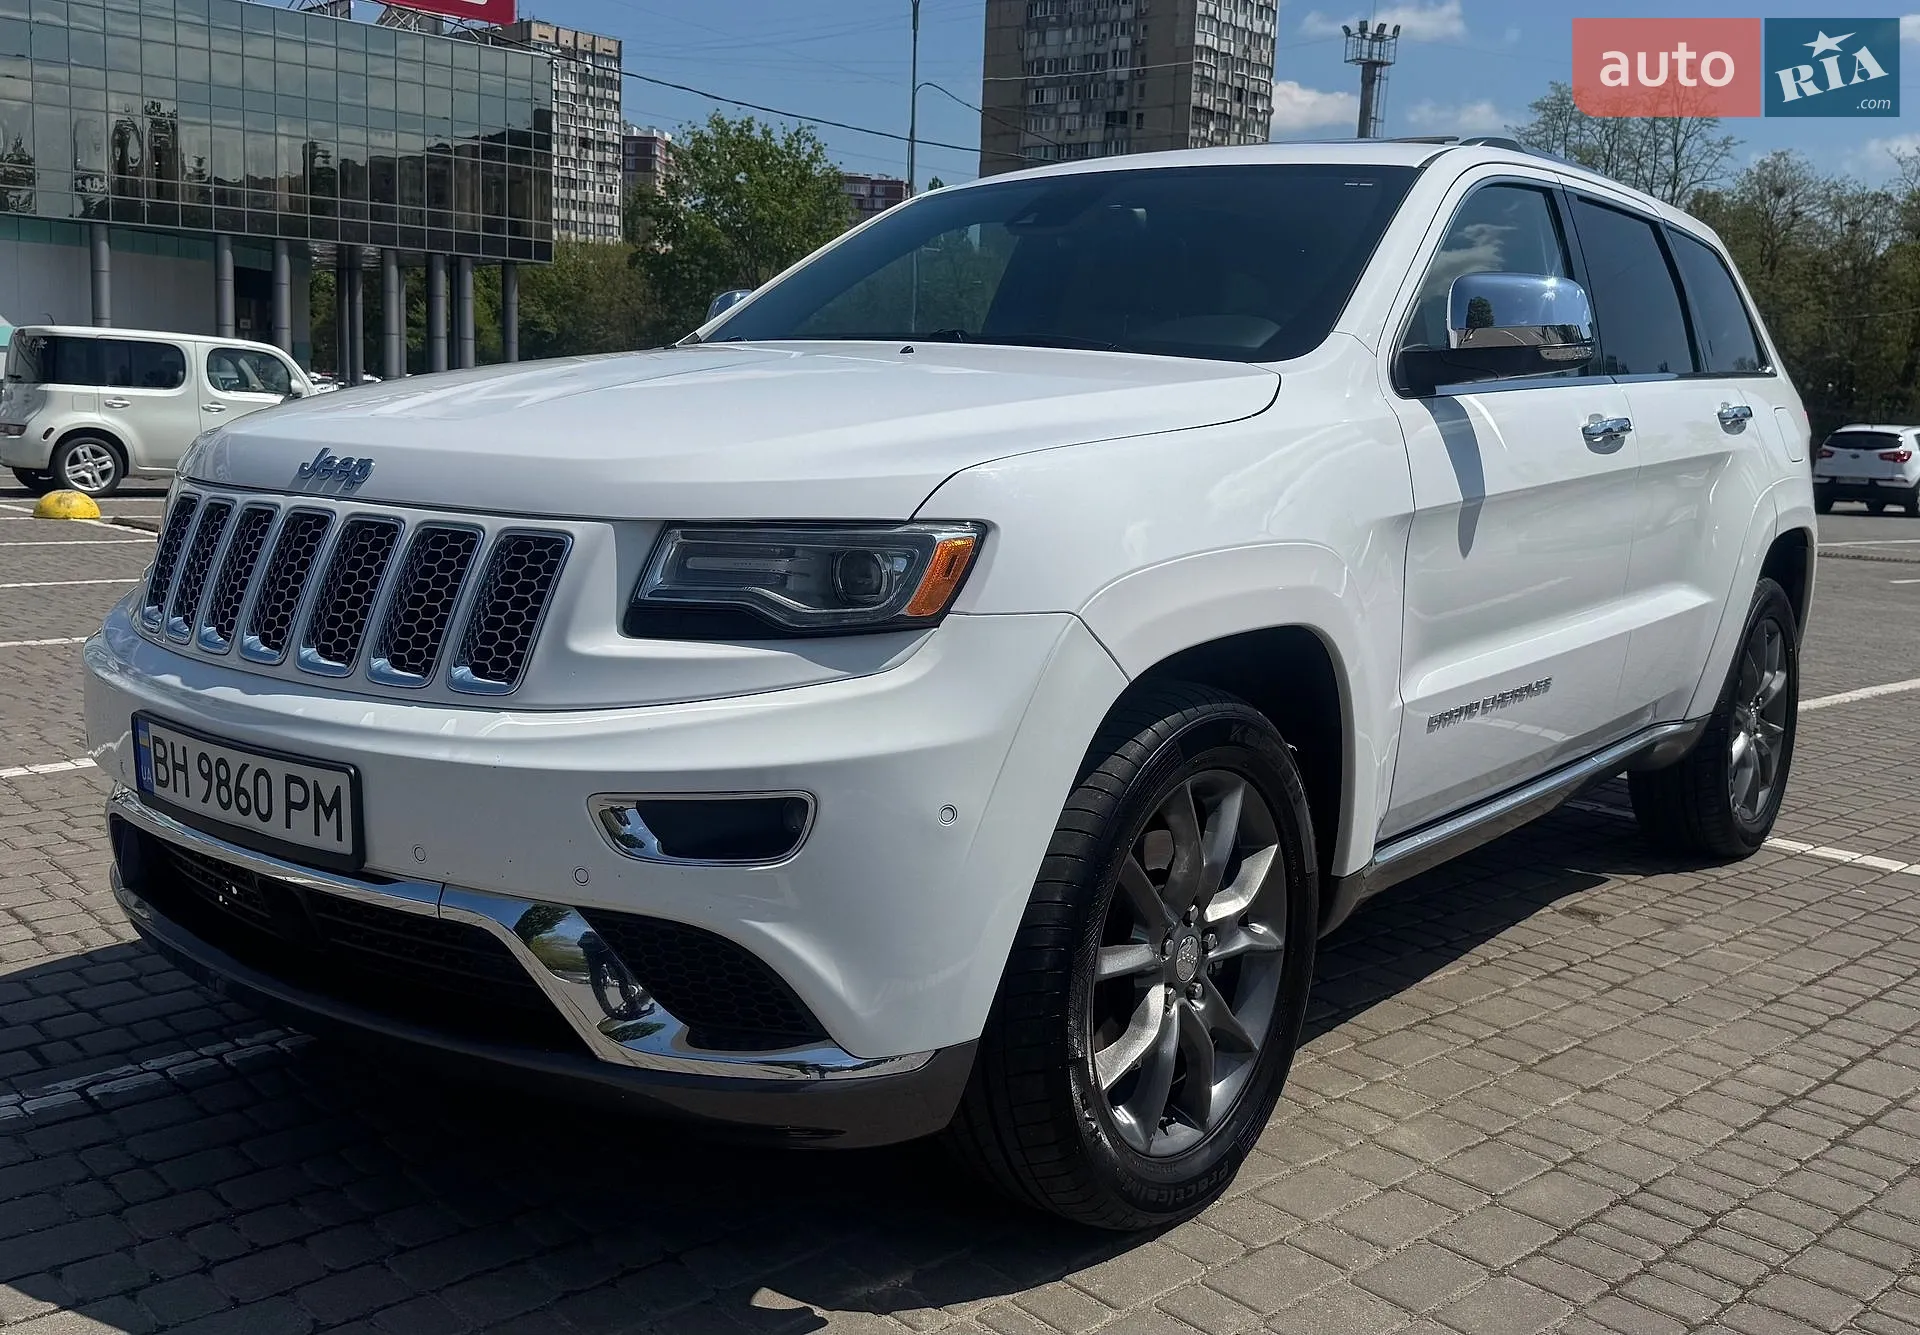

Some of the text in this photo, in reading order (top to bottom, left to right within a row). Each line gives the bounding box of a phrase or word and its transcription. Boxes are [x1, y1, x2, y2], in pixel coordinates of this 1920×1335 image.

[299, 447, 375, 490] Jeep
[141, 766, 152, 784] UA
[152, 735, 343, 842] BH 9860 PM
